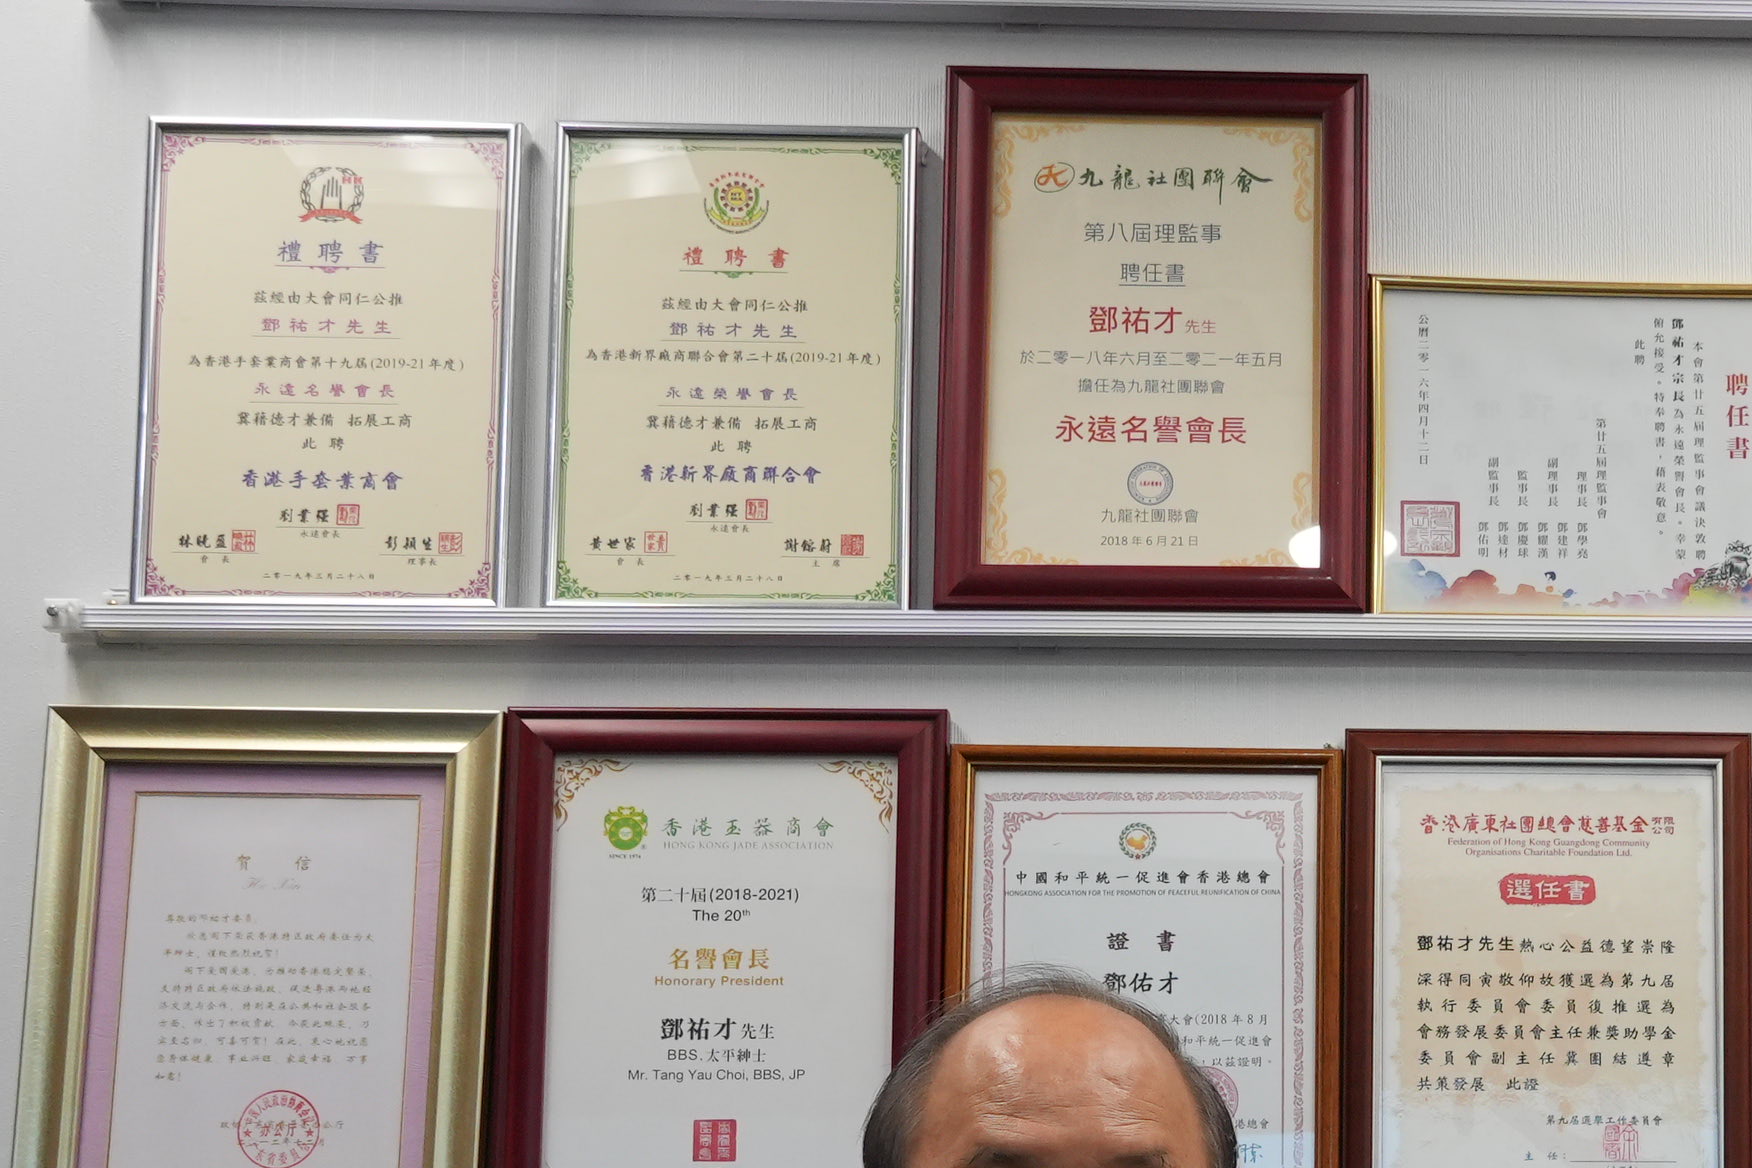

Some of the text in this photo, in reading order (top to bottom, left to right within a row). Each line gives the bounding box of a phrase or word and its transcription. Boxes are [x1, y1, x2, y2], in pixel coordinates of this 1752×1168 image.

[1083, 223, 1222, 243] 第八屆理監事
[277, 241, 384, 262] 禮聘書
[683, 247, 789, 267] 禮聘書
[1120, 263, 1185, 284] 聘任書
[262, 318, 392, 335] 鄧祐才先生
[670, 322, 797, 339] 鄧祐才先生
[1634, 339, 1645, 365] 此聘
[254, 383, 396, 398] 永遠名譽會長
[666, 387, 798, 401] 永遠榮譽會長
[1078, 379, 1225, 394] 擔任為九龍社團聯會
[1726, 373, 1750, 460] 聘任書
[1055, 416, 1247, 444] 永遠名譽會長
[302, 438, 345, 451] 此聘
[711, 440, 752, 453] 此聘
[641, 465, 821, 483] 香港新界廠商聯合會
[1596, 419, 1607, 519] 第廿五屆理監事會
[242, 471, 403, 490] 香港手套業商會
[1488, 457, 1499, 507] 副監事長
[1517, 471, 1528, 507] 監事長
[1548, 458, 1558, 507] 副理事長
[1577, 471, 1587, 507] 理事長
[1101, 508, 1199, 523] 九龍社團聯會
[664, 841, 698, 849] HONG
[1448, 838, 1491, 846] Federation
[1504, 838, 1526, 847] Hong
[1529, 838, 1550, 847] Kong
[1554, 839, 1600, 847] Guangdong
[1603, 839, 1650, 848] Community
[1466, 849, 1521, 857] Organisations
[1016, 871, 1270, 884] 中國和平統一促進會香港總會
[1507, 879, 1590, 900] 選任書
[693, 909, 751, 922] The 20th
[1108, 931, 1175, 952] 證書
[670, 949, 769, 970] 名譽會長
[654, 975, 784, 988] Honorary President
[628, 1070, 805, 1083] Mr. Tang Yau Choi, BBS, JP
[1507, 1077, 1539, 1091] 此證
